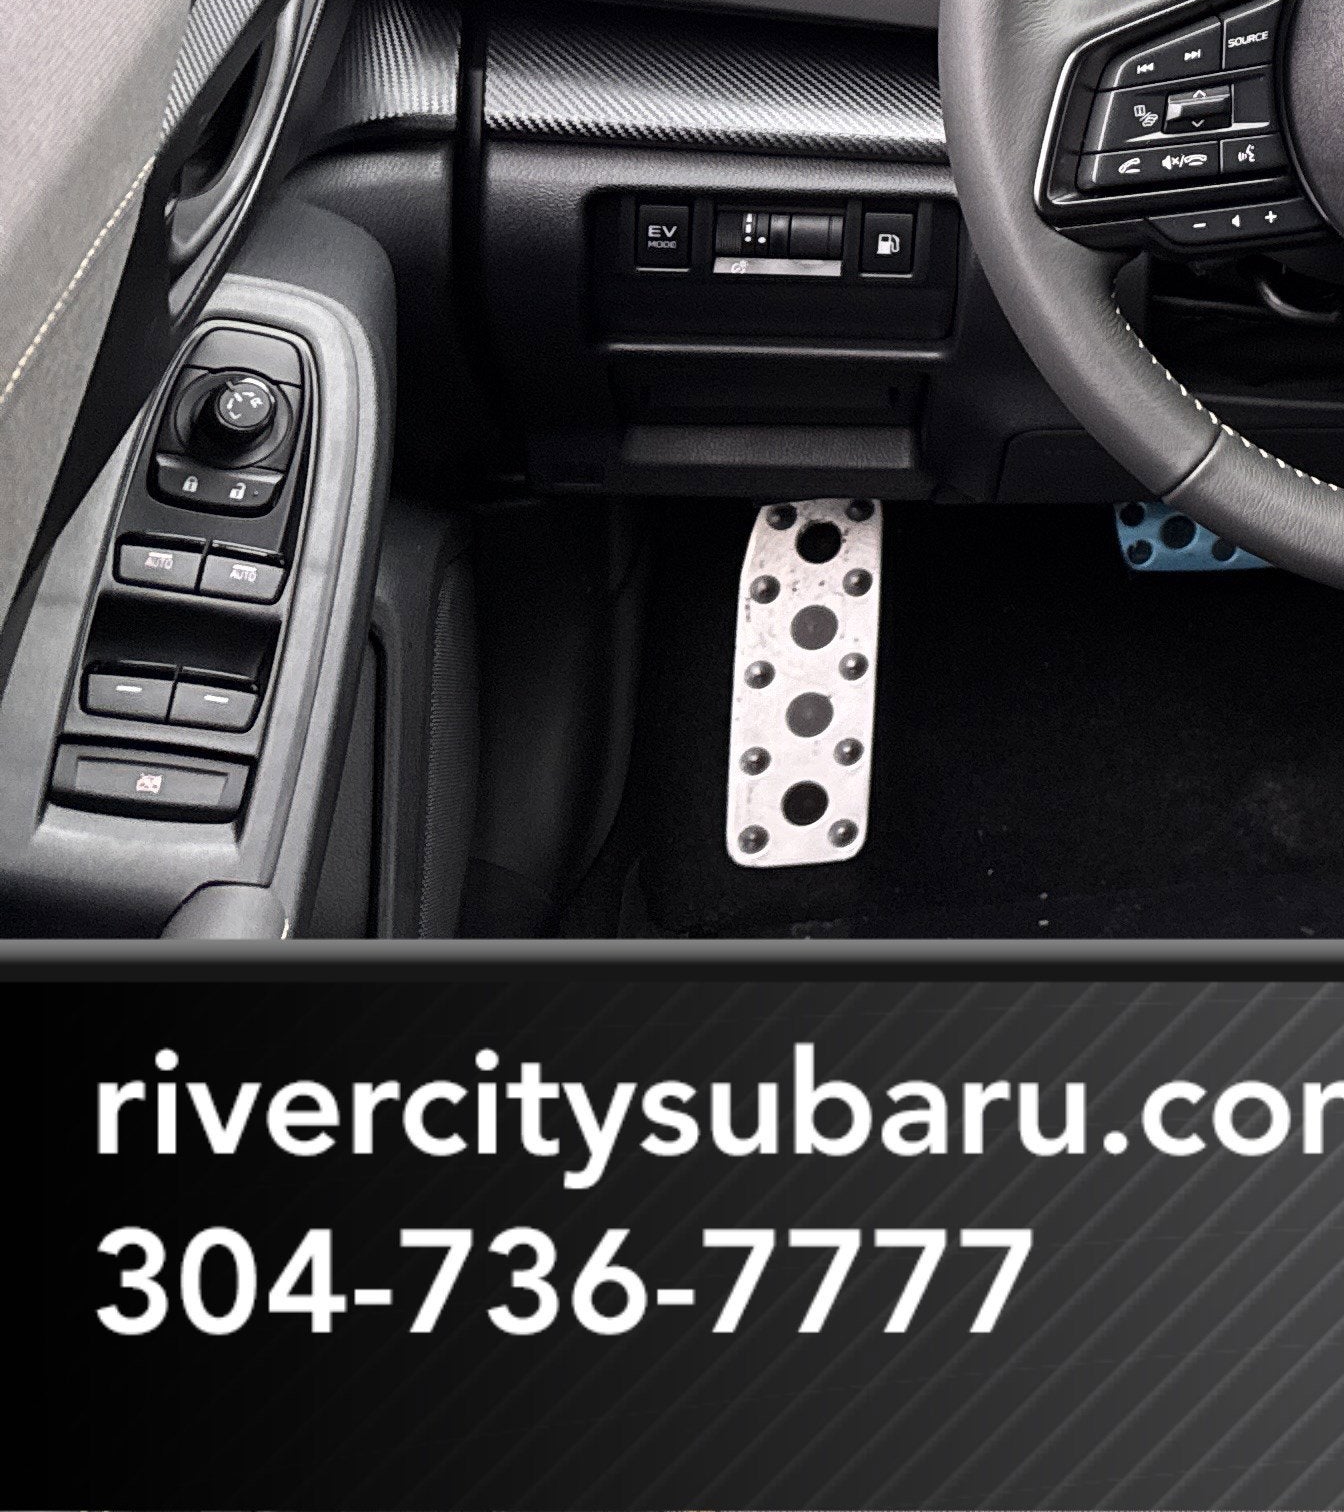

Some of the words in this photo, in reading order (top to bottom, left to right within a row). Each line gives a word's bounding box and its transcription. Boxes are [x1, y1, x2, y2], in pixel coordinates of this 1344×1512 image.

[1227, 31, 1269, 48] SOURCE
[648, 225, 678, 238] EV
[647, 240, 677, 249] MODE
[144, 557, 174, 570] AUTO
[229, 569, 257, 583] AUTO
